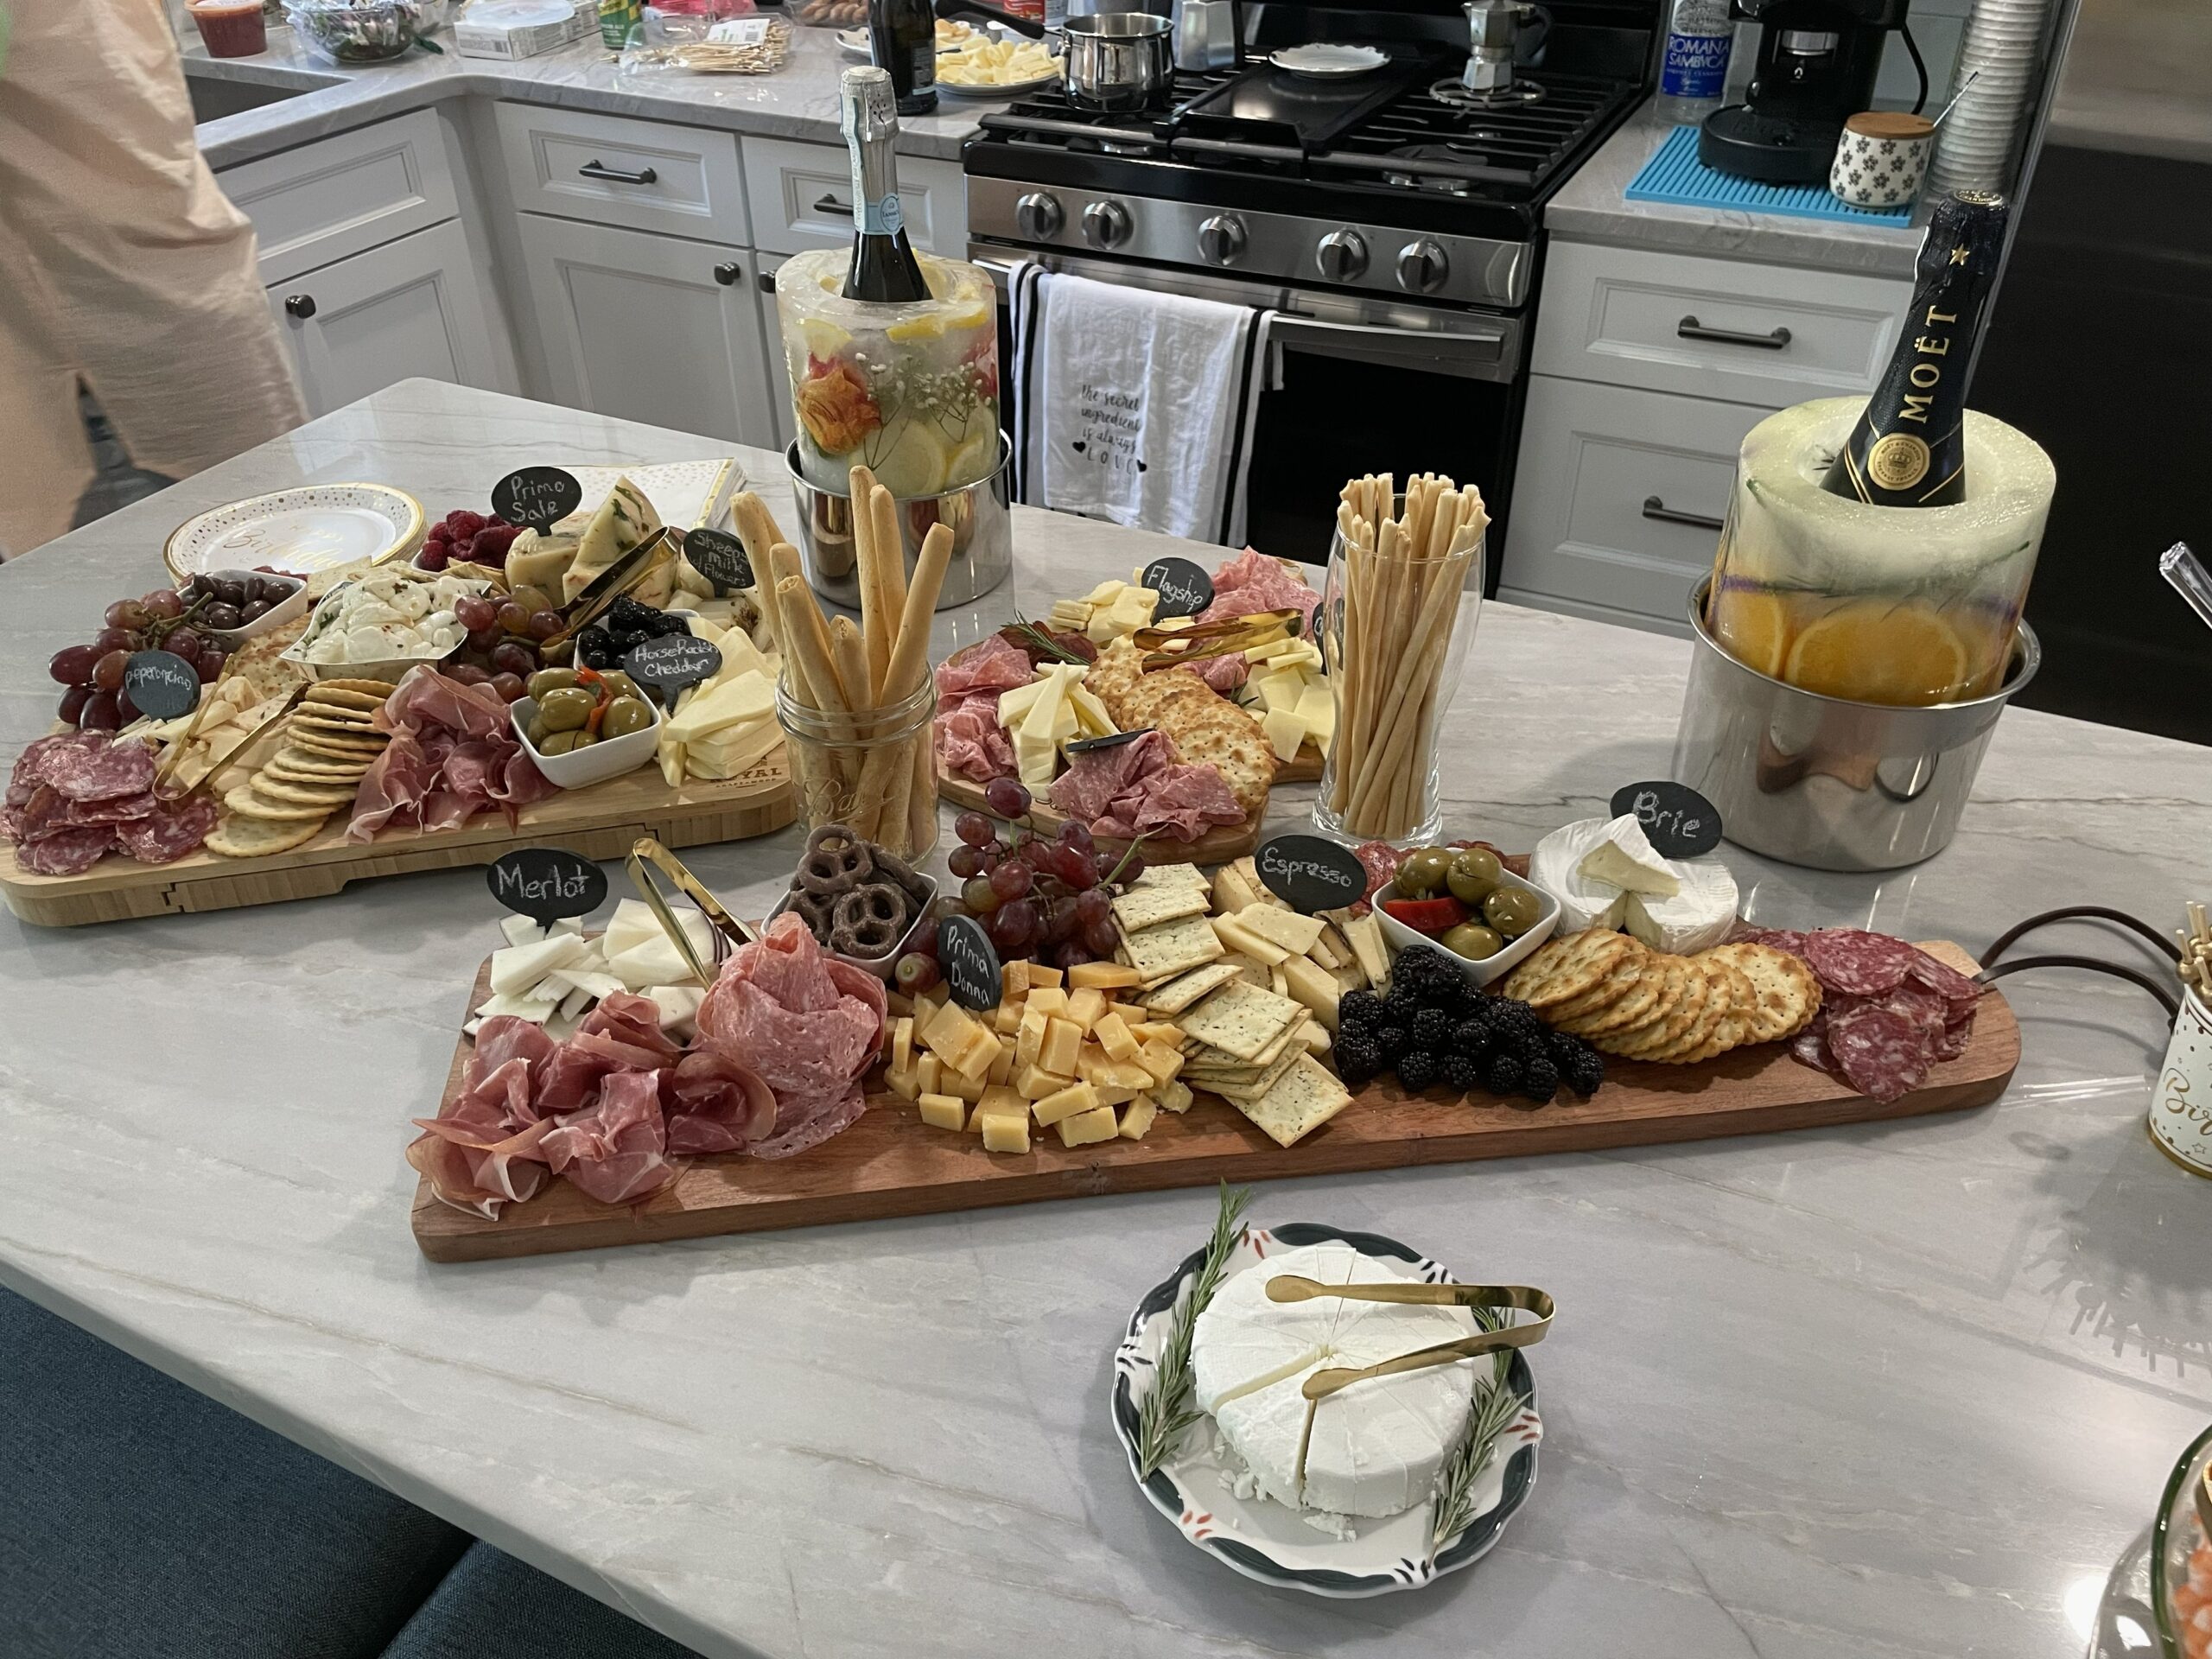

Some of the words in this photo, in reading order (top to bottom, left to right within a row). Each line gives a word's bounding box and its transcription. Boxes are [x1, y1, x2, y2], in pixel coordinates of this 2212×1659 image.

[1668, 35, 1730, 54] ROMANA
[1897, 304, 1958, 424] MOËT
[510, 499, 559, 523] Sale
[1147, 564, 1204, 613] Flagship
[1630, 790, 1701, 838] Brie
[495, 863, 591, 900] Merlot
[1262, 847, 1352, 887] Espresso
[947, 925, 989, 979] Prima
[951, 960, 991, 1007] Donna
